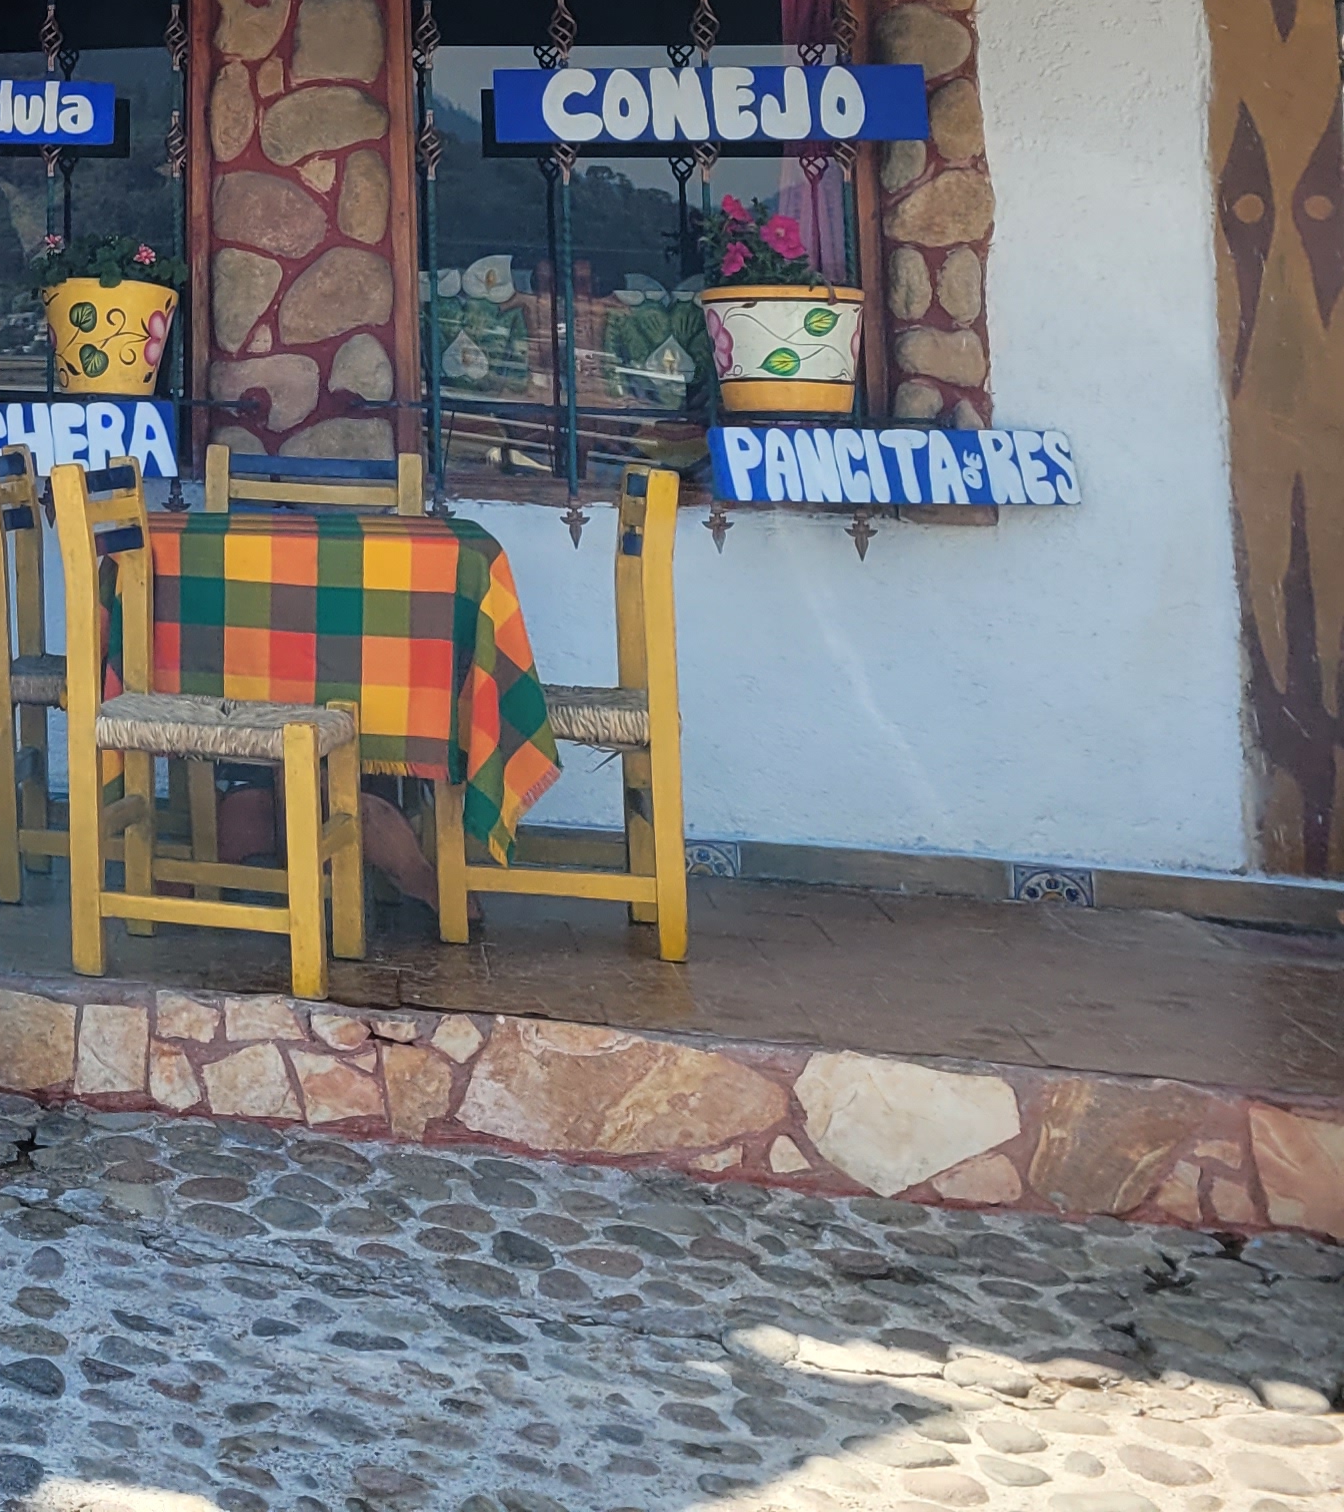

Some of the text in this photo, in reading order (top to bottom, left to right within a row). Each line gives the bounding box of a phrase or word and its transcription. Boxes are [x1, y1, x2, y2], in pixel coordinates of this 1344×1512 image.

[541, 66, 866, 141] CONEJO
[723, 427, 1081, 505] PANCITA DE RES
